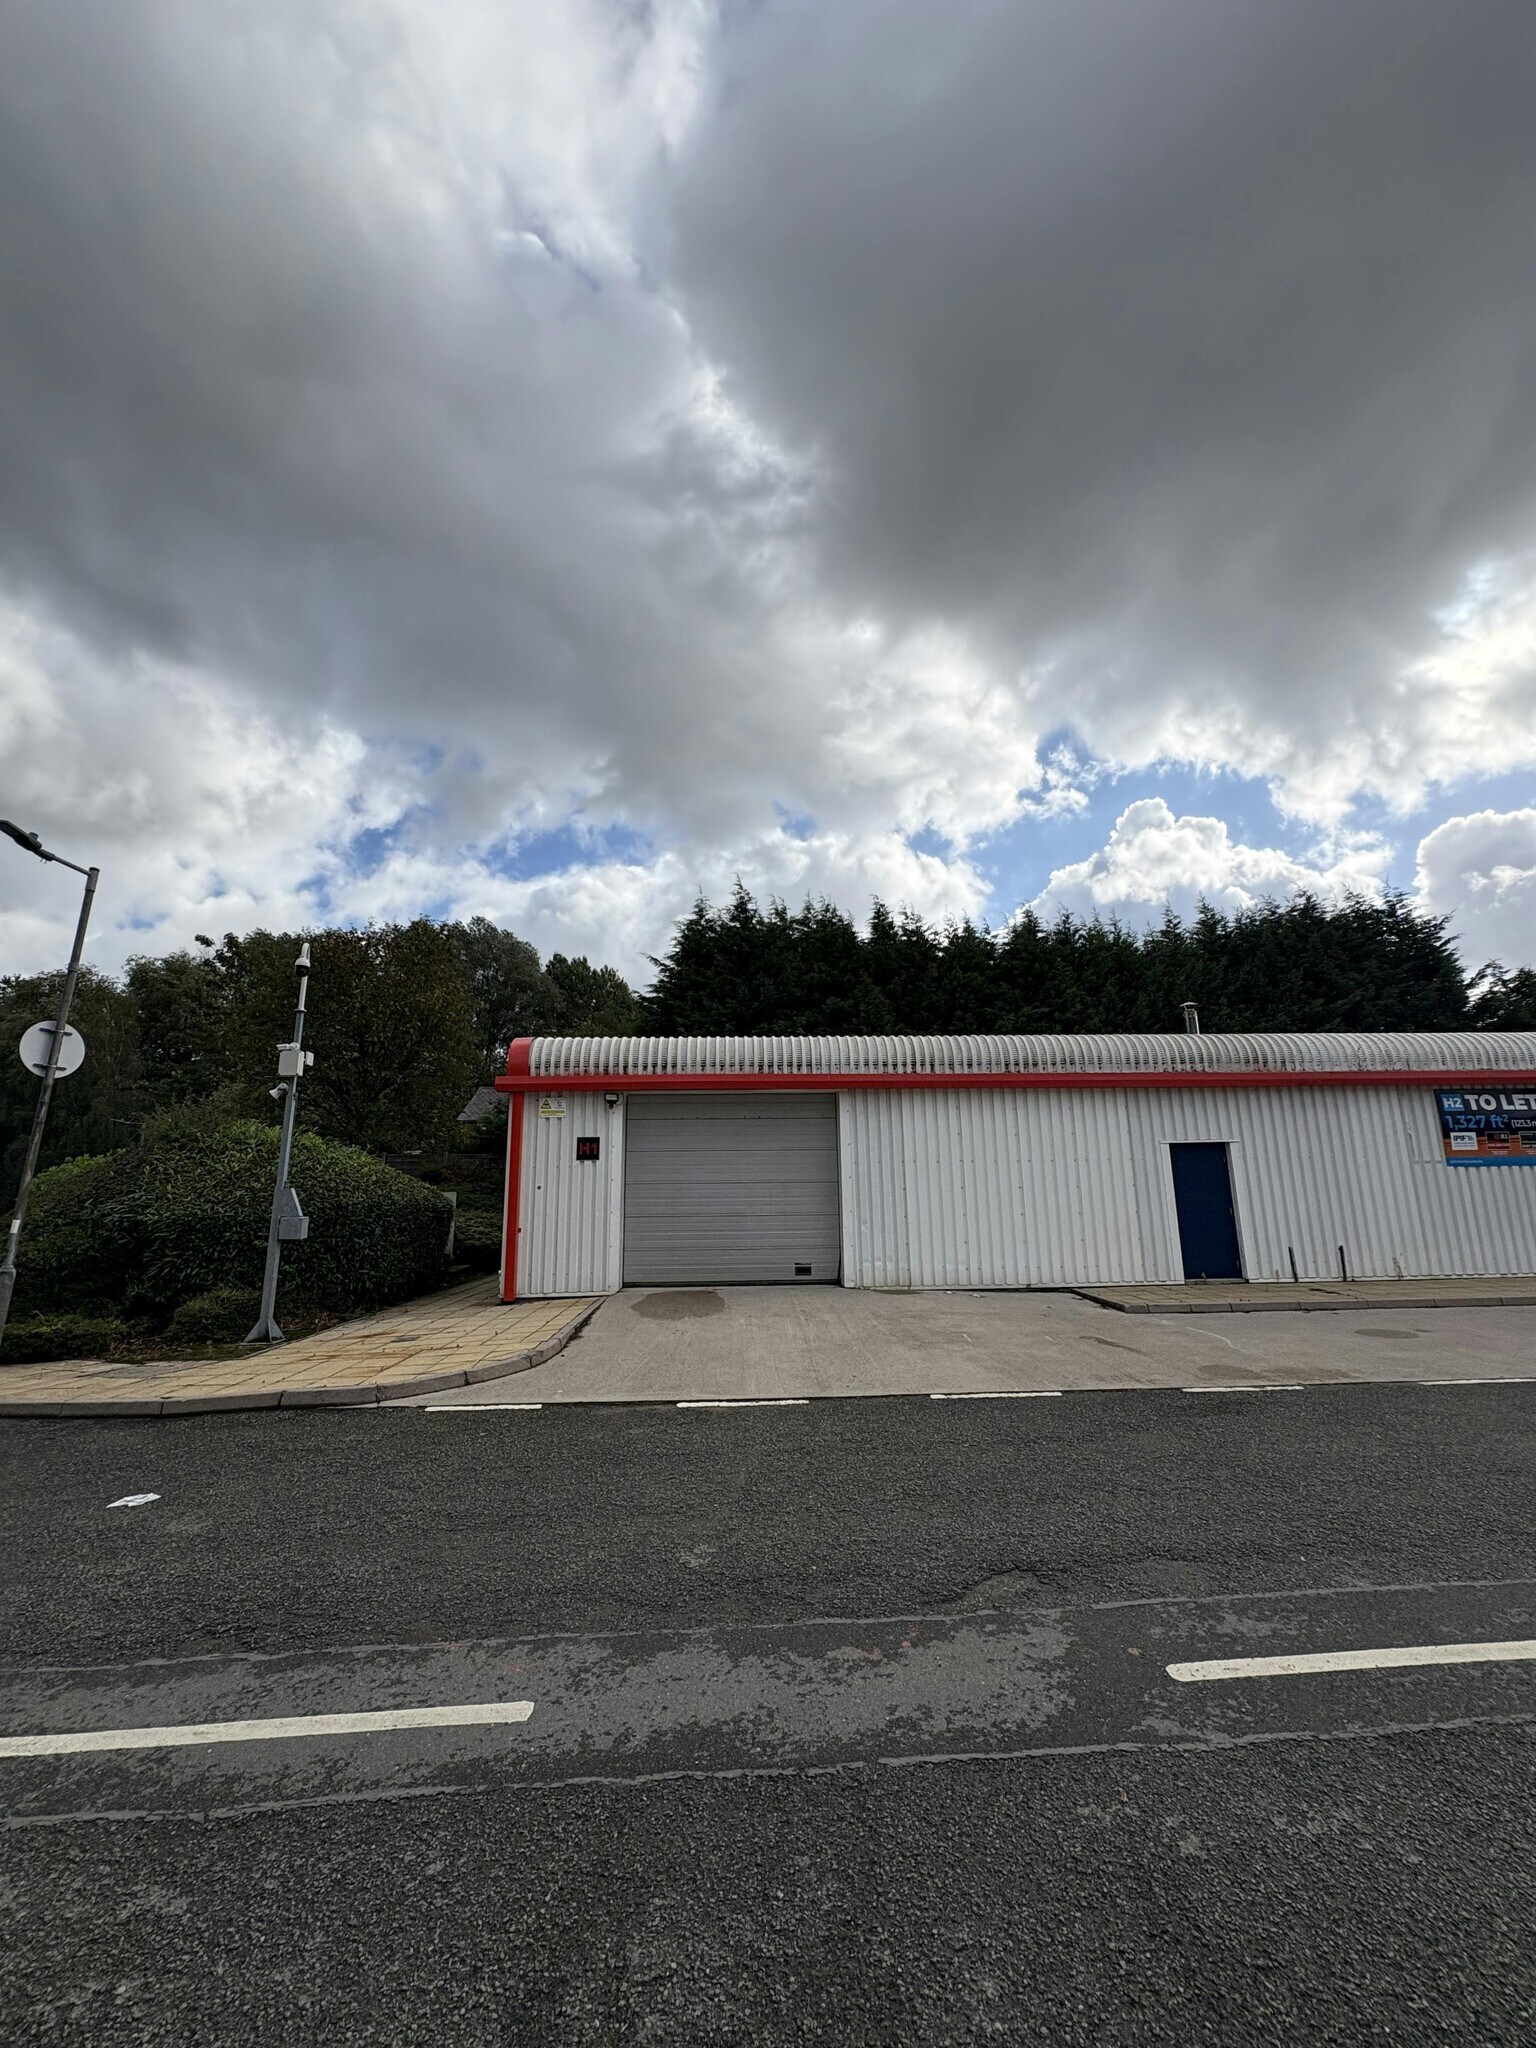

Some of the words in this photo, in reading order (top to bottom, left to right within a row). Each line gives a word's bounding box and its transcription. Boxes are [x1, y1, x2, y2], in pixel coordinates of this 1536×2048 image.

[1443, 1097, 1463, 1108] H2
[1464, 1094, 1497, 1111] TO
[1499, 1094, 1536, 1111] LET
[1445, 1115, 1486, 1131] 1,327
[579, 1142, 598, 1156] H1
